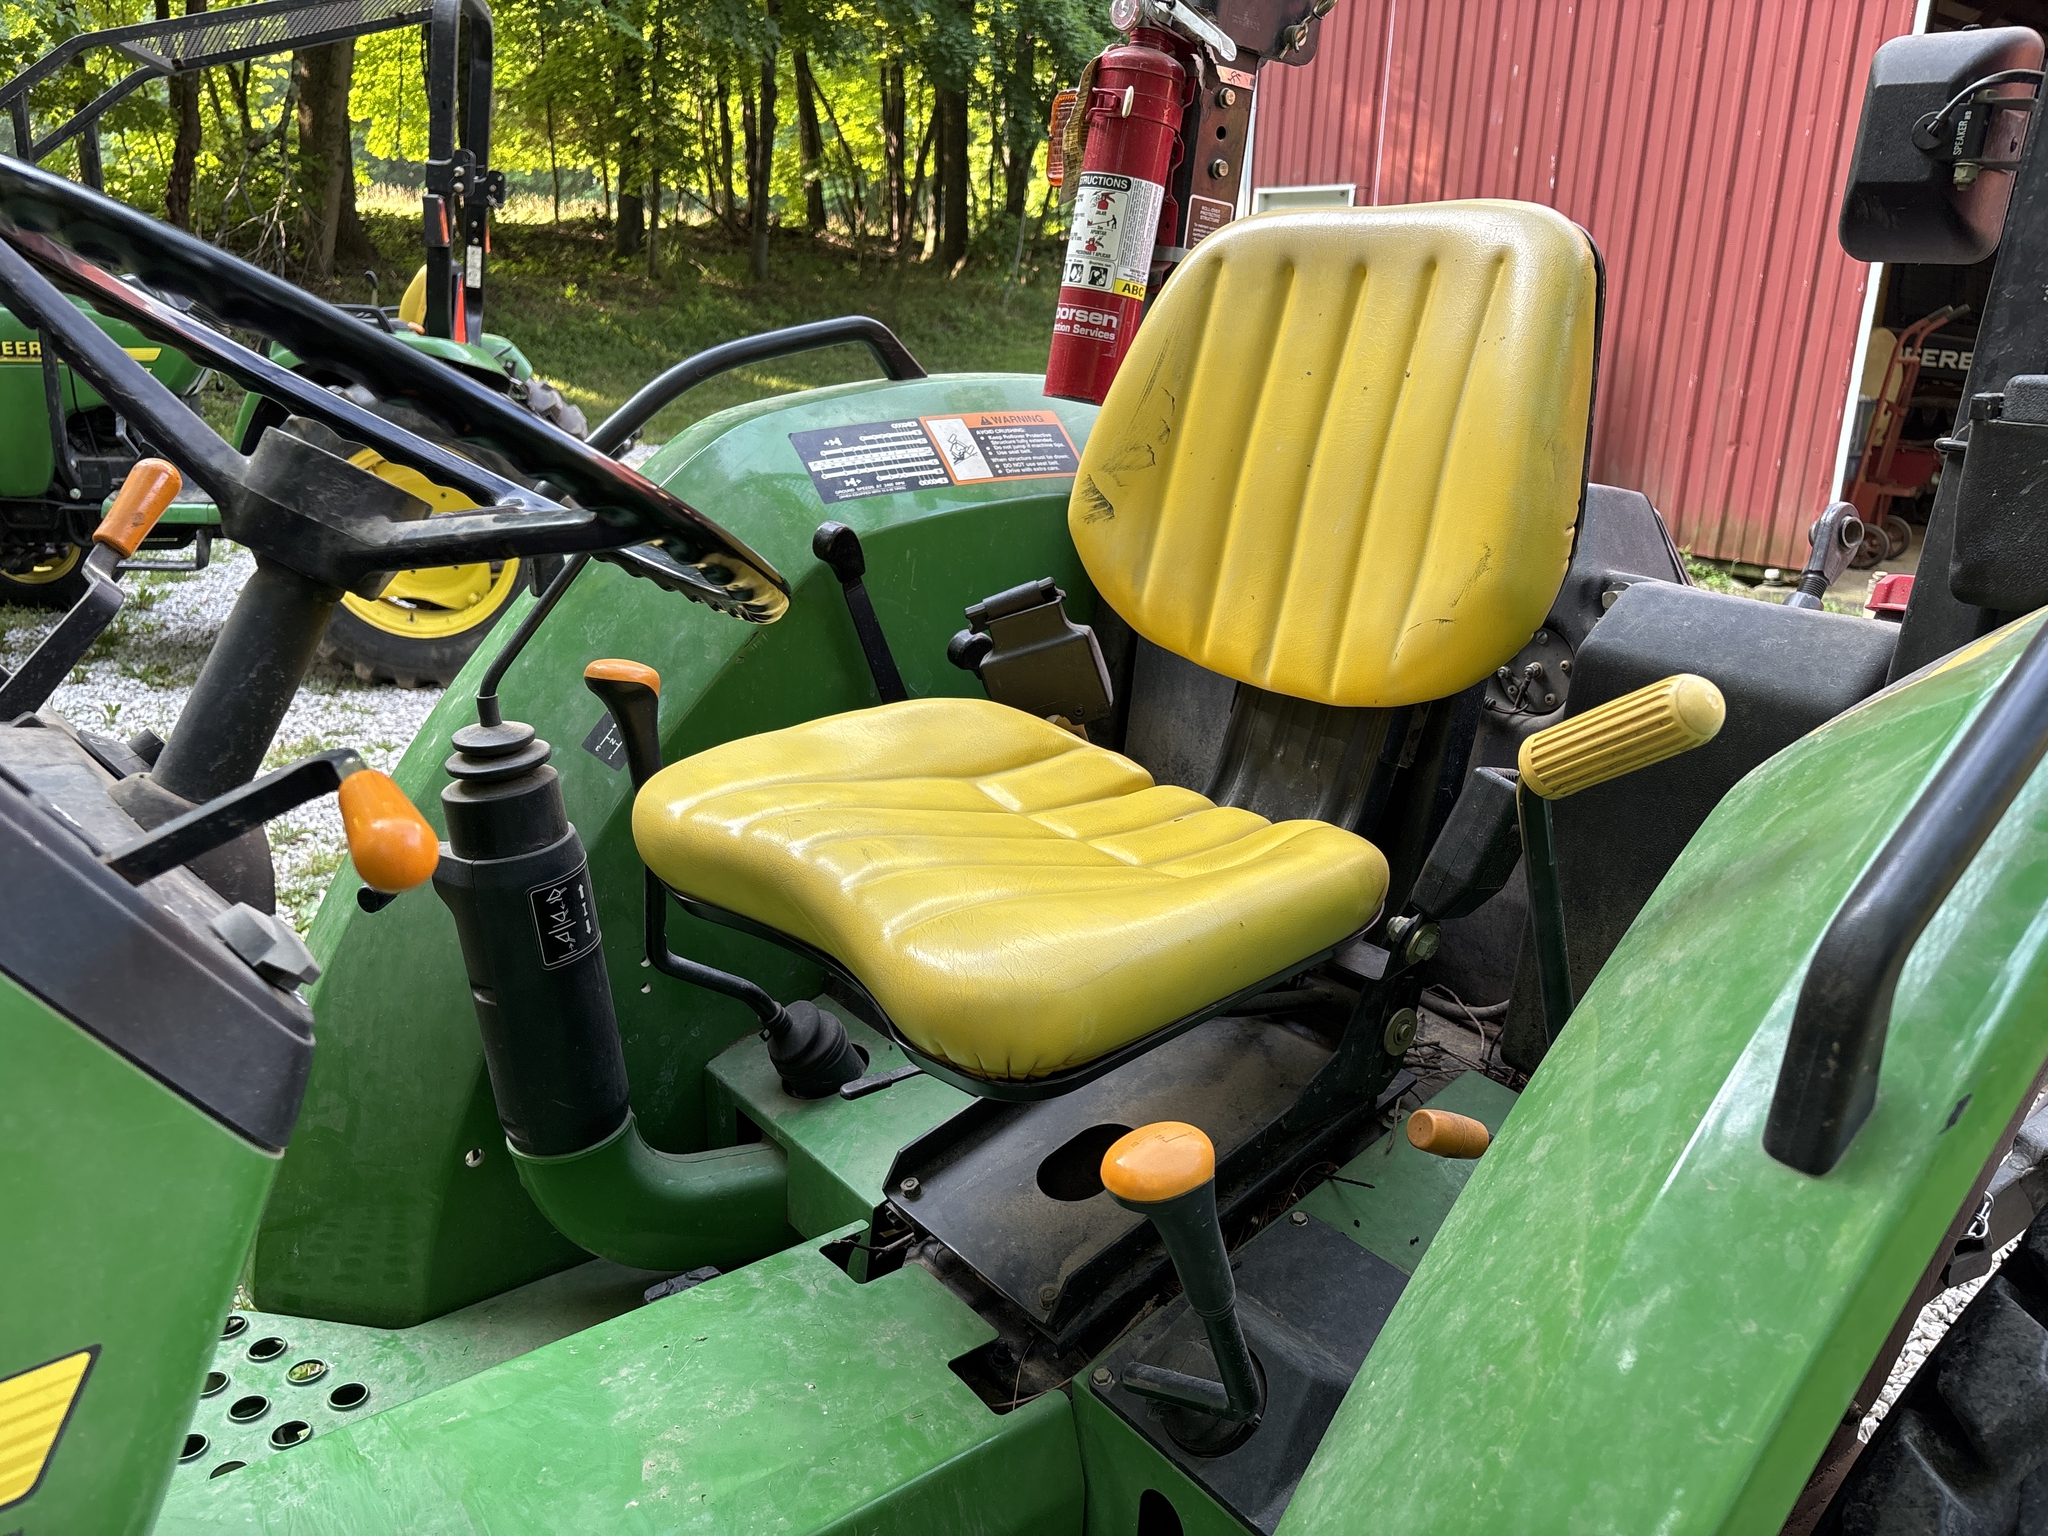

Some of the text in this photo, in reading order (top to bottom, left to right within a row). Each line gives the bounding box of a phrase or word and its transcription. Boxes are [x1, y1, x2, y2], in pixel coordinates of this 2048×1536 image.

[1953, 120, 1969, 156] SPEAKER
[1121, 283, 1145, 298] ABC
[1072, 324, 1116, 341] Services
[991, 414, 1044, 424] WARNING
